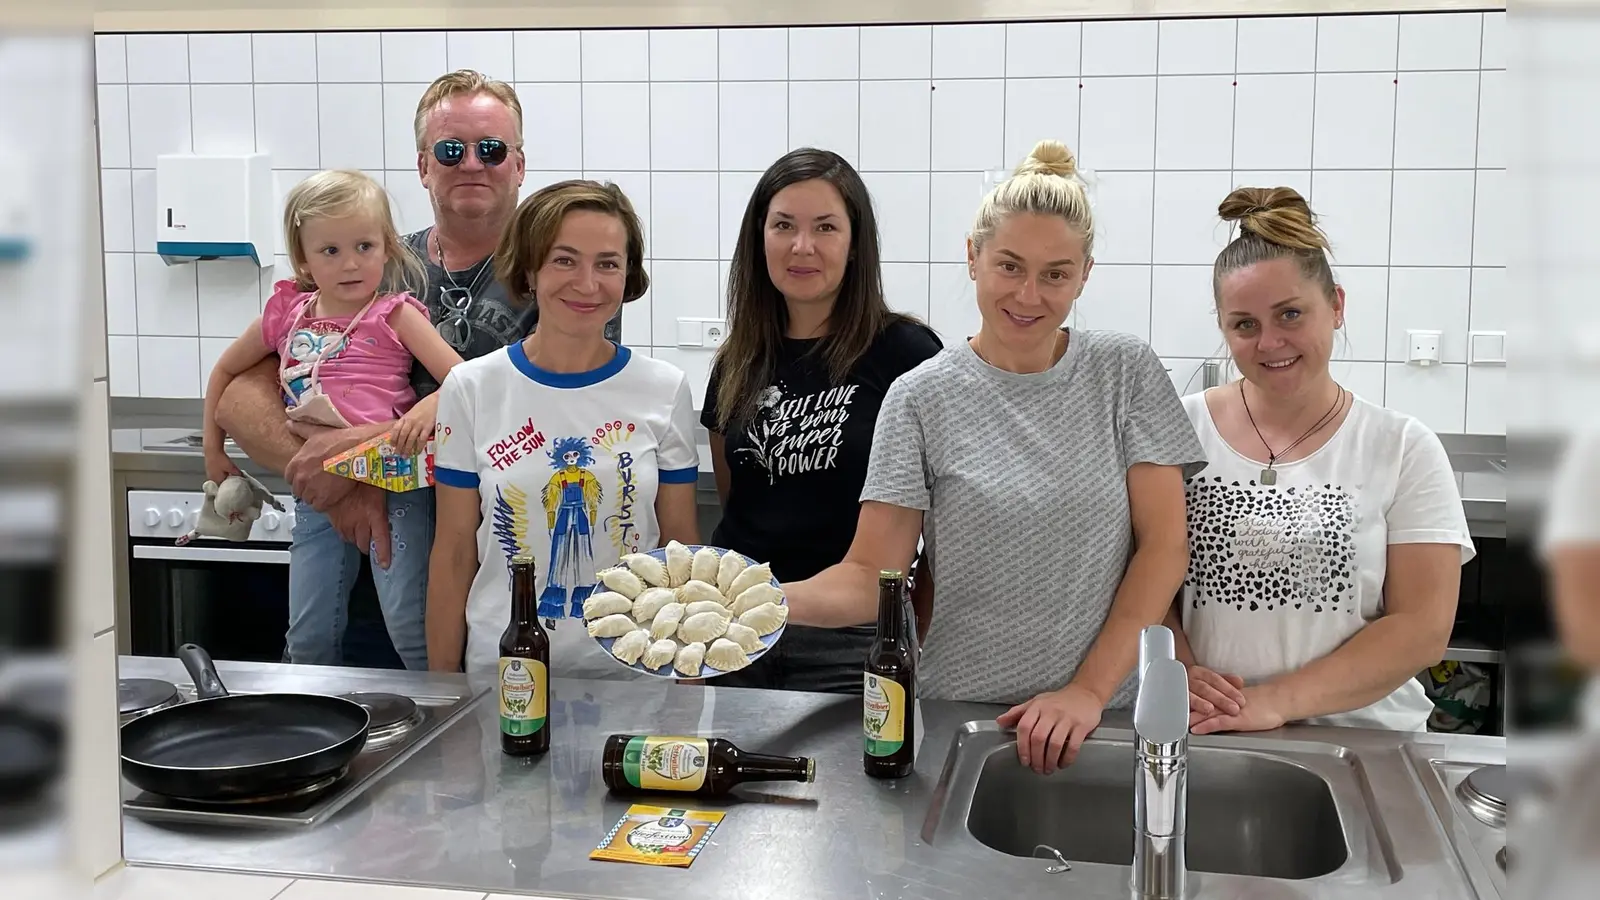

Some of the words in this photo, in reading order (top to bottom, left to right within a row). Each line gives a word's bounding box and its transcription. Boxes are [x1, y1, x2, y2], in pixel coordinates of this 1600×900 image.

[770, 393, 815, 422] SELF
[814, 384, 860, 411] LOVE
[770, 420, 793, 437] is
[800, 406, 850, 431] your
[487, 417, 536, 462] FOLLOW
[492, 448, 522, 471] THE
[522, 431, 546, 455] SUN
[771, 423, 843, 457] super
[778, 446, 838, 476] POWER
[618, 451, 636, 548] BURST
[1236, 517, 1285, 527] start
[1239, 526, 1285, 540] today
[1234, 536, 1270, 547] with
[1237, 545, 1296, 560] grateful
[1249, 557, 1288, 569] heart
